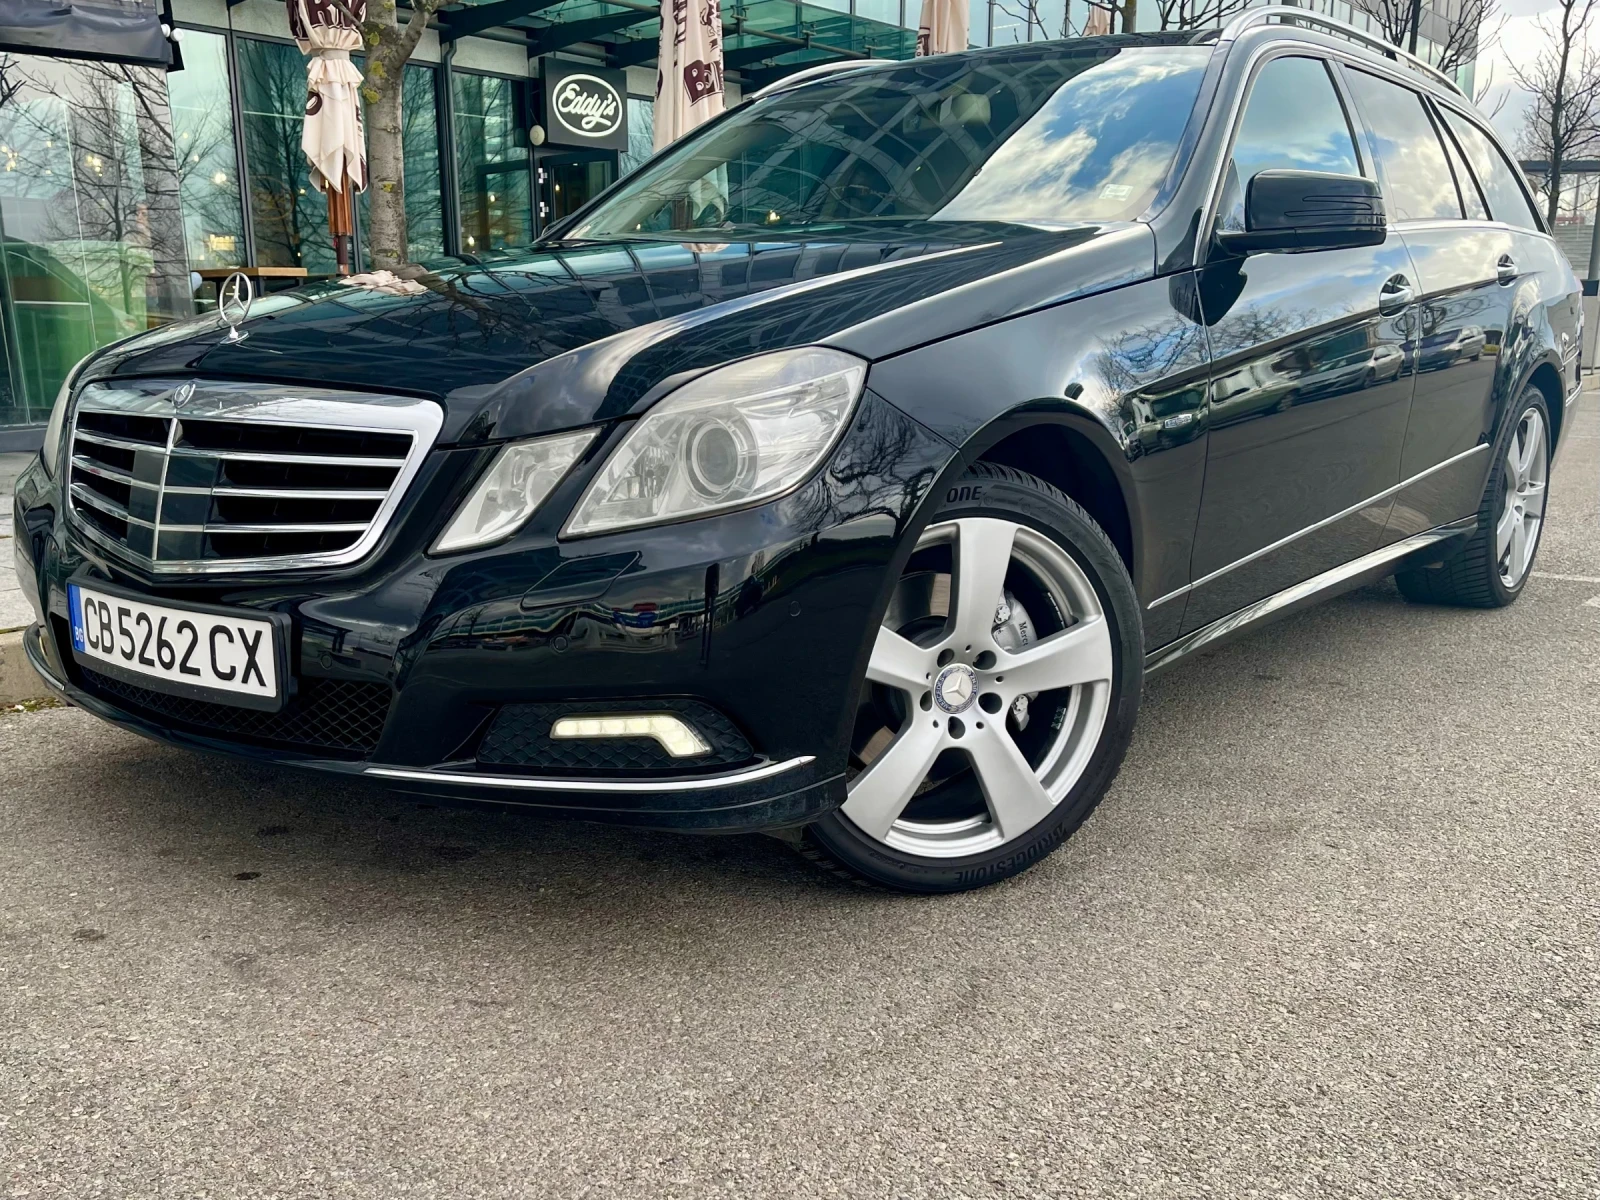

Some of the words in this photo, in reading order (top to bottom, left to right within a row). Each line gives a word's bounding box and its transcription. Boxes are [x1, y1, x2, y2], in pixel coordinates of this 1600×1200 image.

[558, 83, 616, 129] Eddy's
[75, 626, 84, 643] BG
[84, 597, 114, 655] CB
[117, 606, 201, 677] 5262
[209, 624, 267, 687] CX
[954, 822, 1067, 884] BRIDGESTONE
